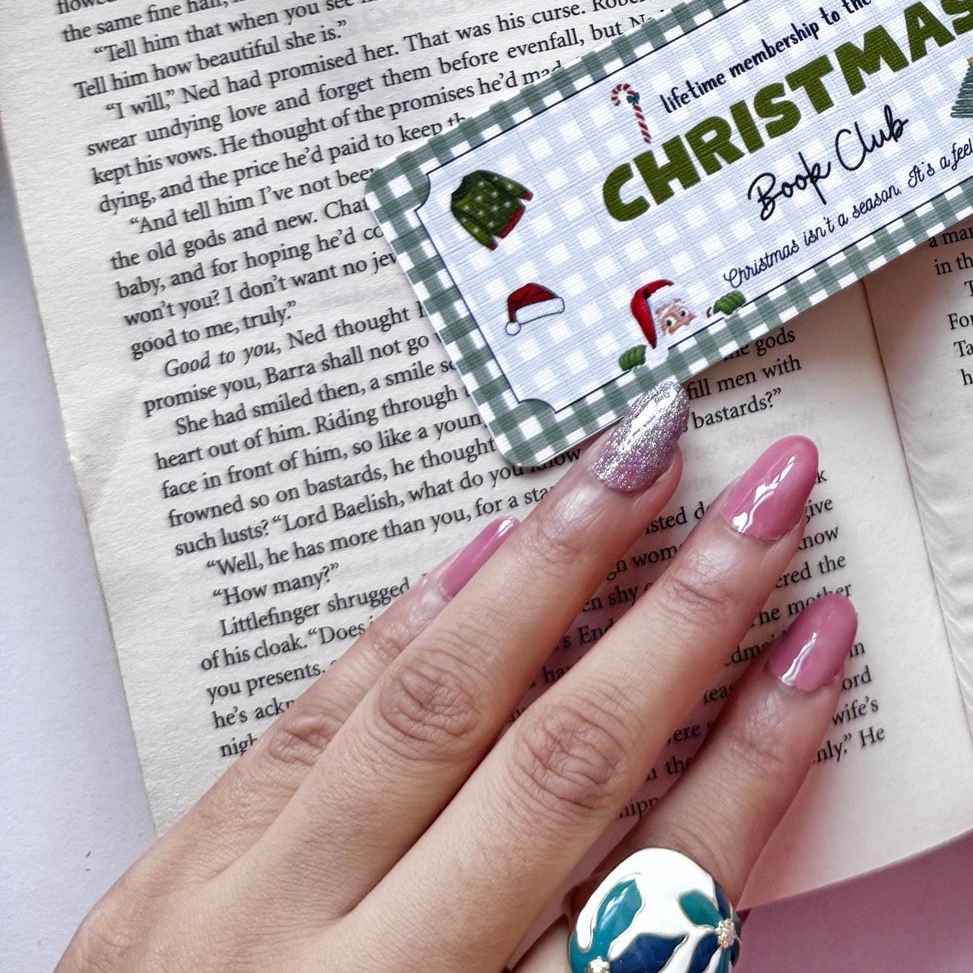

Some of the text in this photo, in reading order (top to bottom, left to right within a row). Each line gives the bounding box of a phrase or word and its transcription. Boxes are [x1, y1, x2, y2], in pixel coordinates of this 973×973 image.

[179, 78, 222, 104] Ned
[224, 68, 263, 94] had
[267, 46, 359, 89] promised
[361, 43, 400, 63] her.
[402, 29, 451, 52] That
[454, 22, 492, 40] was
[495, 13, 526, 33] his
[531, 3, 586, 25] curse.
[660, 70, 726, 114] lifetime
[729, 20, 820, 78] membership
[821, 5, 841, 26] to
[747, 104, 909, 222] Book Club
[723, 238, 800, 289] Christmas
[804, 215, 836, 246] isn't
[837, 209, 850, 227] a
[852, 183, 902, 218] season.
[907, 161, 936, 189] It's
[939, 152, 952, 171] a
[130, 327, 178, 361] good
[180, 328, 201, 344] to
[204, 320, 240, 339] me,
[163, 306, 411, 377] Good to you, Ned thought
[755, 328, 796, 356] gods
[686, 354, 802, 400] fill men with
[265, 546, 290, 566] he
[292, 540, 326, 560] has
[328, 528, 378, 552] more
[381, 517, 425, 538] than
[429, 508, 472, 533] you,
[474, 496, 503, 518] for
[507, 495, 519, 509] a
[219, 602, 321, 638] Littlefinger
[206, 663, 326, 705] you presents.
[859, 726, 886, 748] He
